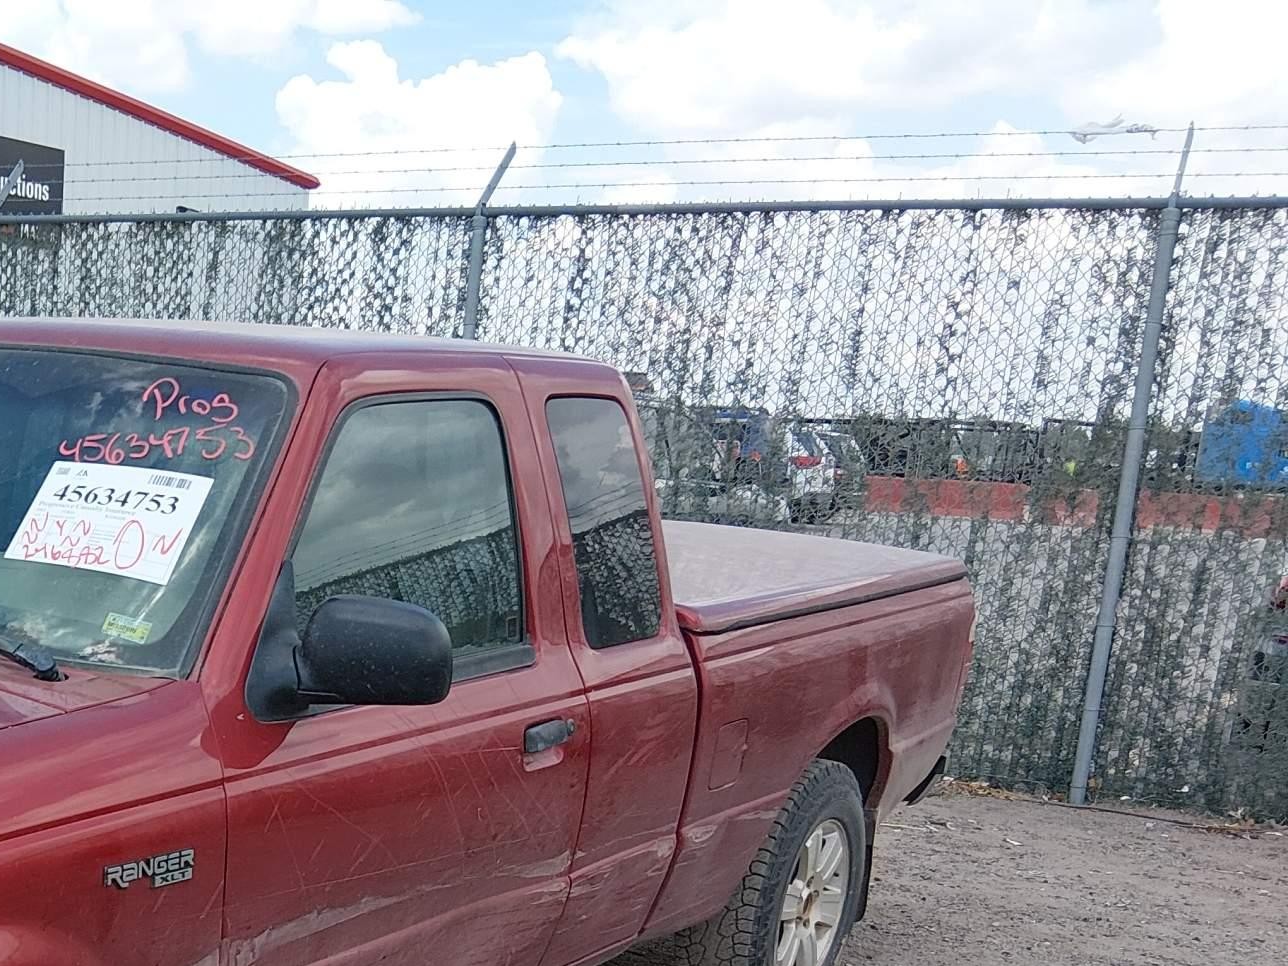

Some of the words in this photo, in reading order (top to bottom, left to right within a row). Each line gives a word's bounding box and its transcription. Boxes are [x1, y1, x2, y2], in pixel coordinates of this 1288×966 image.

[143, 377, 239, 423] Prog
[53, 484, 180, 515] 45634753
[103, 847, 195, 889] RANGER
[159, 870, 189, 885] XLT
